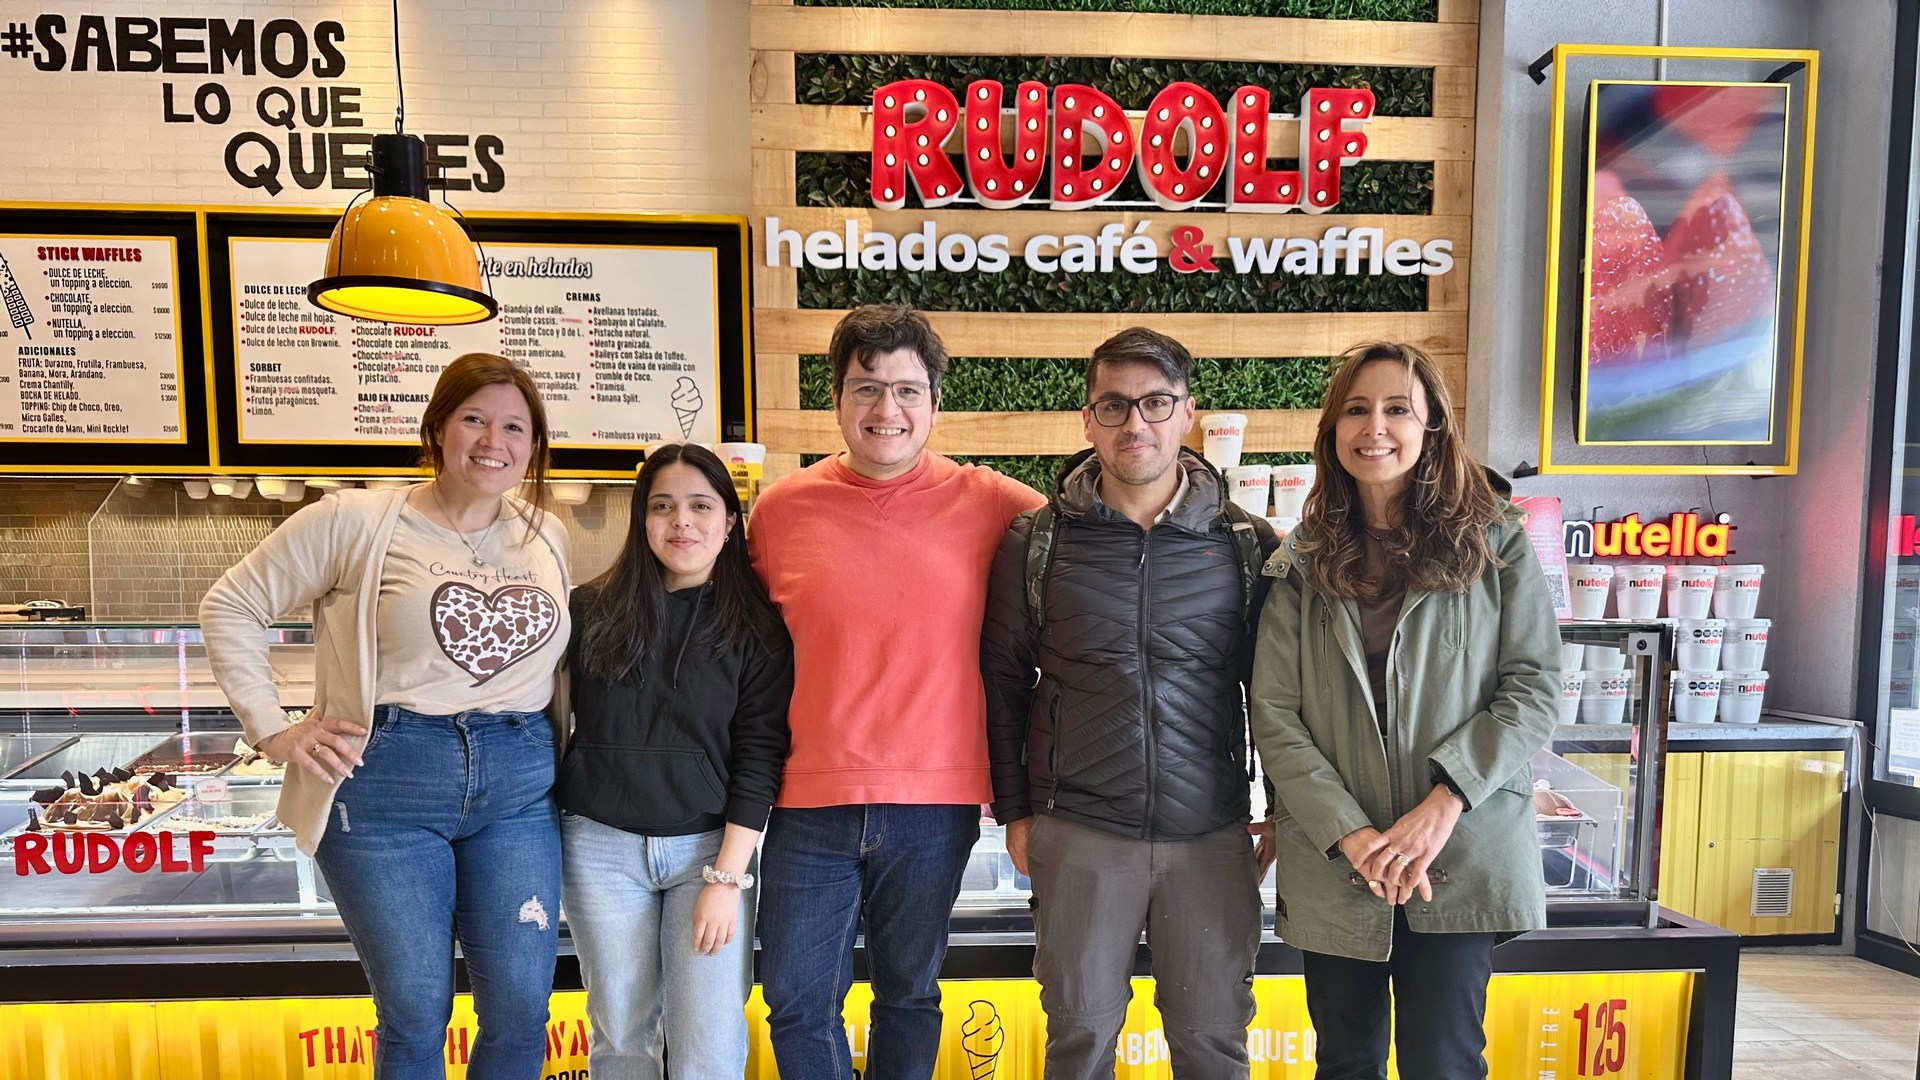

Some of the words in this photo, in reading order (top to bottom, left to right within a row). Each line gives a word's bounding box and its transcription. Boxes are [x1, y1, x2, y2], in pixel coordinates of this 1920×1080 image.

[0, 13, 346, 79] #SABEMOS
[163, 82, 231, 124] LO
[256, 85, 363, 130] QUE
[871, 80, 1376, 215] RUDOLF
[224, 131, 506, 197] QUEES
[765, 217, 1009, 273] helados
[1024, 218, 1158, 274] café
[1170, 225, 1219, 274] &
[1227, 226, 1453, 276] waffles
[37, 246, 80, 261] STICK
[81, 247, 142, 262] WAFFLES
[505, 261, 525, 277] en
[528, 257, 593, 278] helados
[49, 268, 71, 278] DULCE
[73, 269, 82, 278] DE
[84, 269, 108, 279] LECHE,
[50, 279, 60, 288] un
[61, 278, 90, 291] topping
[244, 285, 272, 294] DULCE
[273, 286, 284, 295] DE
[50, 293, 93, 304] CHOCOLATE,
[566, 292, 601, 302] CREMAS
[52, 304, 61, 312] un
[63, 303, 92, 316] topping
[245, 299, 265, 309] Dulce
[267, 300, 276, 310] de
[278, 300, 301, 310] leche.
[504, 305, 532, 316] Gianduja
[534, 306, 545, 315] del
[593, 307, 625, 316] Avellanas
[245, 312, 266, 321] Dulce
[267, 312, 277, 322] de
[278, 312, 299, 322] leche
[300, 313, 312, 323] mil
[313, 313, 337, 324] hojas.
[504, 316, 532, 325] Crumble
[246, 324, 265, 334] Dulce
[267, 325, 276, 334] de
[277, 325, 298, 334] Leche
[356, 326, 393, 336] Chocolate
[504, 326, 526, 336] Crema
[528, 327, 536, 336] de
[537, 327, 554, 337] Coco
[567, 328, 575, 337] de
[594, 329, 623, 338] Pistacho
[54, 329, 63, 338] un
[64, 328, 94, 341] topping
[246, 338, 265, 347] Dulce
[267, 338, 275, 347] de
[276, 338, 296, 348] leche
[297, 340, 310, 348] con
[356, 338, 393, 348] Chocolate
[394, 340, 409, 349] con
[505, 337, 527, 346] Lemon
[594, 339, 615, 349] Menta
[18, 346, 76, 356] ADICIONALES
[505, 348, 527, 358] Crema
[595, 350, 619, 361] Baileys
[634, 350, 653, 360] Salsa
[654, 351, 663, 360] de
[18, 358, 43, 368] FRUTA:
[106, 360, 147, 370] Frambuesa,
[250, 363, 282, 372] SORBET
[357, 362, 396, 373] Chocolate
[425, 365, 439, 373] con
[595, 361, 616, 370] Crema
[617, 361, 626, 370] de
[627, 362, 646, 371] vaina
[647, 362, 656, 371] de
[657, 362, 682, 371] vainilla
[19, 370, 47, 379] Banana,
[49, 370, 69, 379] Mora,
[250, 374, 292, 384] Frambuesas
[595, 372, 623, 380] crumble
[624, 372, 632, 381] de
[19, 380, 42, 389] Crema
[20, 391, 42, 400] BOCHA
[43, 391, 52, 400] DE
[250, 385, 277, 396] Naranja
[251, 396, 273, 405] Frutos
[358, 393, 377, 402] BAJO
[379, 394, 388, 402] EN
[597, 393, 621, 402] Banana
[21, 402, 51, 411] TOPPING:
[51, 402, 67, 414] Chip
[68, 403, 78, 412] de
[78, 402, 103, 413] Choco,
[104, 403, 123, 413] Oreo,
[21, 413, 41, 422] Micro
[358, 415, 380, 424] Crema
[22, 424, 54, 433] Crocante
[55, 424, 64, 433] de
[86, 425, 101, 434] Mini
[359, 426, 383, 435] Frutilla
[1208, 426, 1240, 436] nutella
[598, 431, 635, 440] Frambuesa
[1562, 512, 1731, 558] nutella
[429, 561, 490, 584] Country
[491, 567, 539, 585] Heart
[14, 830, 216, 877] RUDOLF
[1573, 999, 1627, 1076] 125
[1249, 1028, 1298, 1065] QUE
